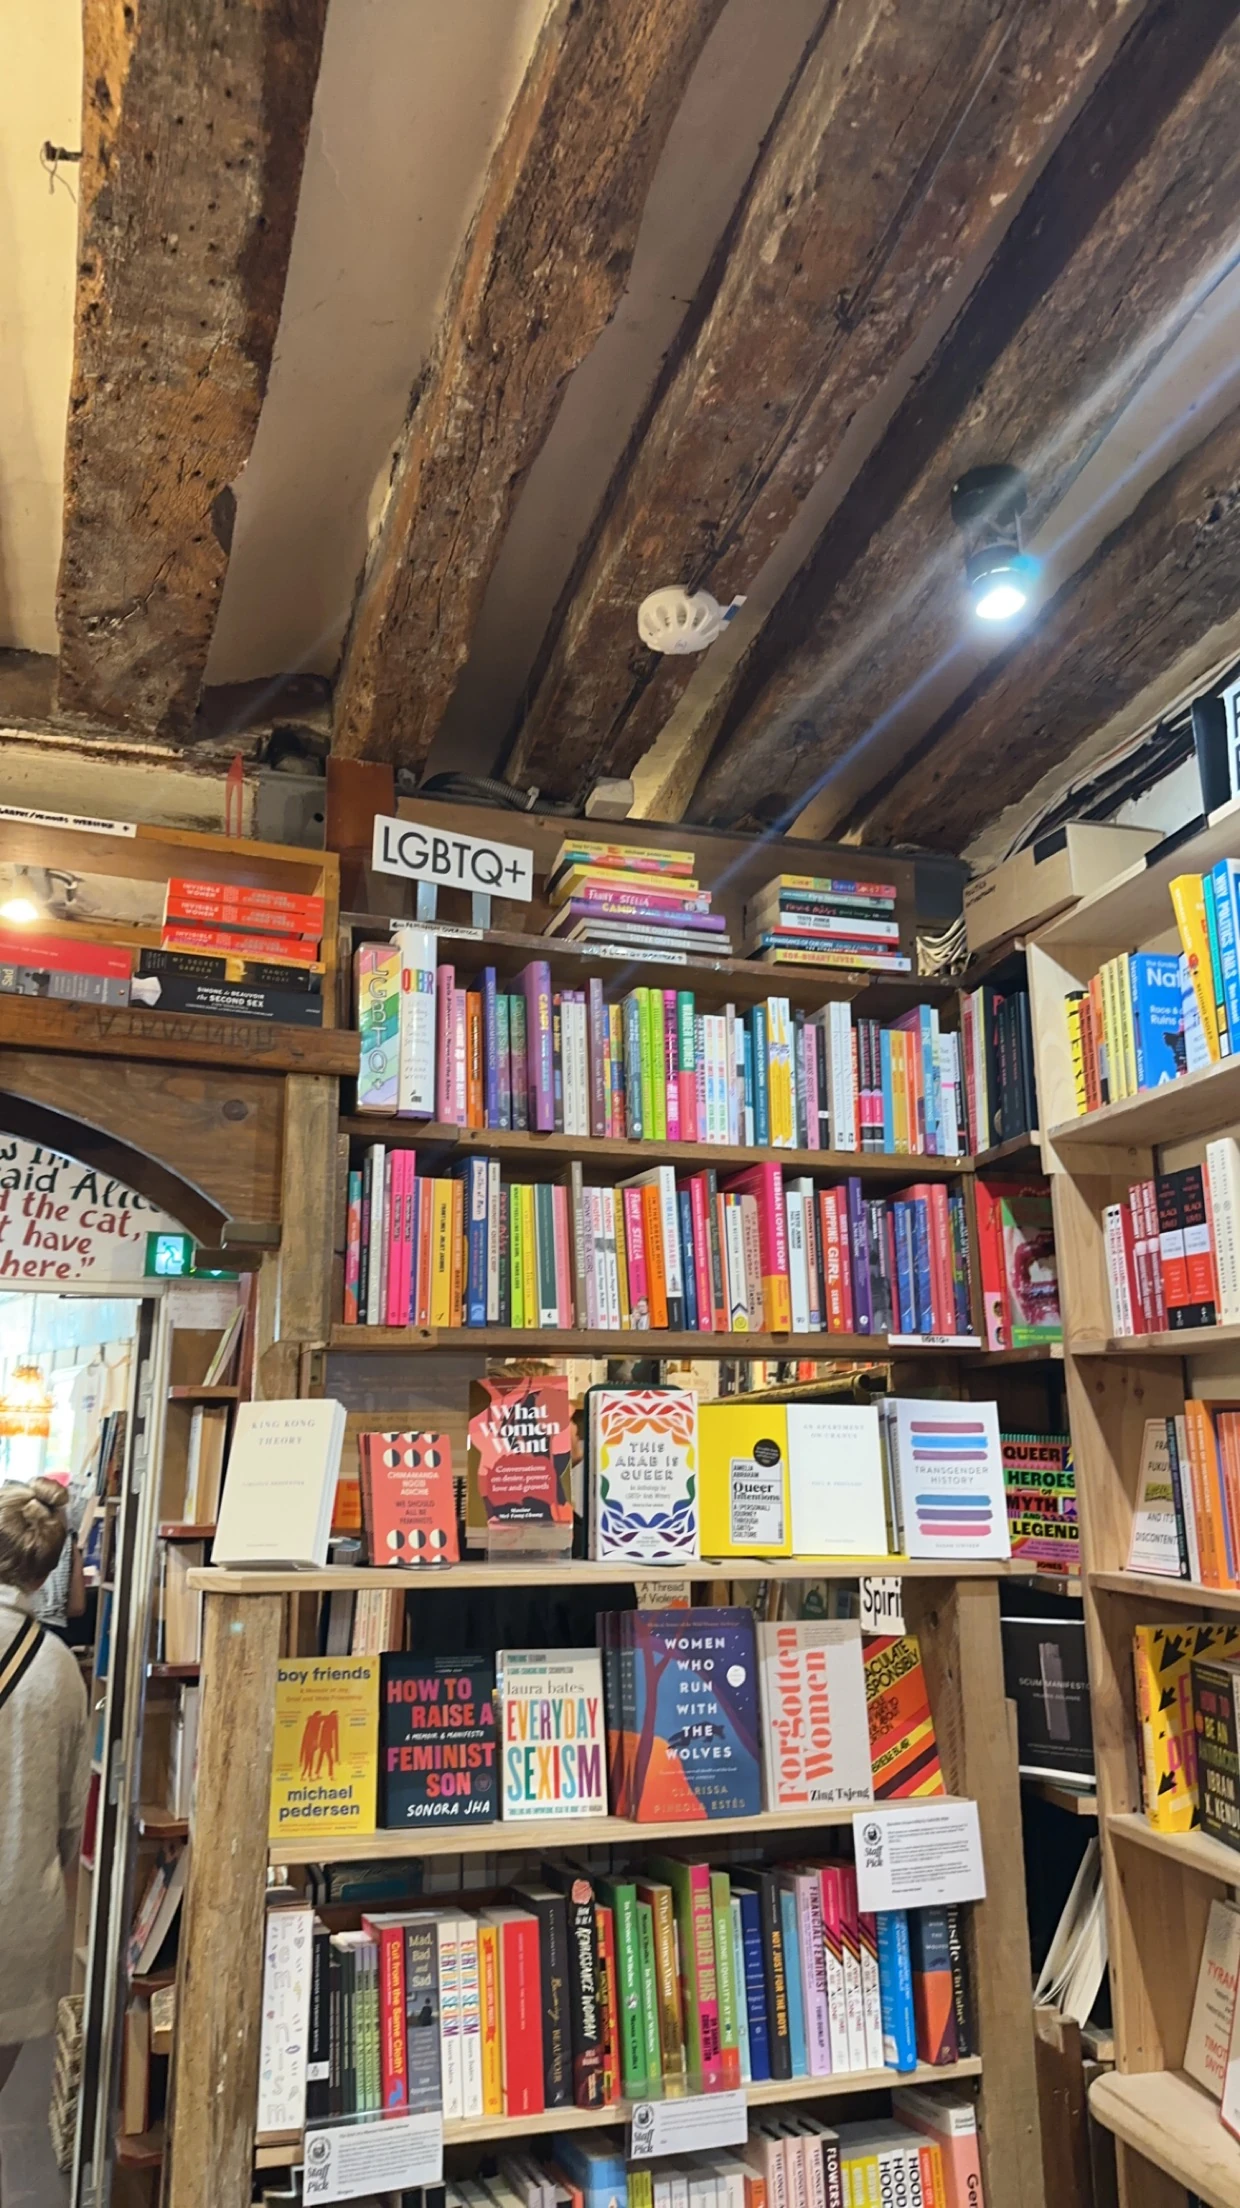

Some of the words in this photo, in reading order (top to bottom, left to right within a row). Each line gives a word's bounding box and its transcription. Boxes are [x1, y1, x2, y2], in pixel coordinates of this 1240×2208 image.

[383, 826, 525, 887] LGBTQ+
[1215, 871, 1228, 897] WHY
[1218, 901, 1234, 948] POLITICS
[1223, 950, 1237, 980] FAILS
[209, 995, 245, 1005] SECOND
[247, 1000, 264, 1008] SEX
[1150, 1014, 1175, 1025] Ruins
[683, 1038, 694, 1068] WOMEN
[0, 1167, 59, 1193] aid
[69, 1169, 162, 1213] Alic
[773, 1171, 783, 1210] LESBIAN
[23, 1191, 70, 1221] the
[80, 1210, 141, 1242] cat,
[576, 1209, 584, 1235] SISTER
[605, 1196, 613, 1232] Amateur
[824, 1196, 839, 1243] WHIPPING
[774, 1213, 784, 1237] LOVE
[23, 1219, 92, 1254] have
[632, 1227, 644, 1260] STELLA
[577, 1237, 585, 1278] OUTSIDER
[667, 1229, 676, 1269] HUSBANDS
[776, 1240, 785, 1271] STORY
[827, 1247, 839, 1285] GIRL
[831, 1289, 840, 1315] SERANO
[491, 1404, 548, 1421] What
[251, 1419, 279, 1429] KING
[284, 1419, 316, 1428] KONG
[479, 1421, 560, 1438] Women
[258, 1436, 303, 1446] THEORY
[492, 1438, 549, 1454] Want
[629, 1442, 665, 1453] THIS
[615, 1456, 661, 1467] ARAB
[665, 1456, 679, 1467] IS
[1003, 1446, 1061, 1462] QUEER
[495, 1464, 546, 1474] Conversations
[620, 1470, 674, 1481] QUEER
[915, 1466, 989, 1474] TRANSGENDER
[1008, 1471, 1075, 1487] HEROES
[492, 1484, 508, 1492] love
[523, 1483, 550, 1493] growth
[733, 1482, 774, 1493] Queer
[930, 1477, 973, 1485] HISTORY
[1007, 1495, 1058, 1512] MYTH
[1023, 1512, 1041, 1520] AND
[1013, 1521, 1079, 1539] LEGEND
[652, 1582, 685, 1592] Thread
[664, 1637, 726, 1650] WOMEN
[278, 1668, 308, 1685] boy
[313, 1666, 371, 1681] friends
[676, 1659, 715, 1671] WHO
[387, 1679, 440, 1703] HOW
[444, 1677, 472, 1700] TO
[507, 1680, 543, 1695] laura
[548, 1680, 585, 1694] bates
[679, 1681, 713, 1693] RUN
[411, 1703, 475, 1729] RAISE
[479, 1704, 494, 1725] A
[507, 1697, 598, 1741] EVERYDAY
[675, 1703, 718, 1716] WITH
[772, 1627, 809, 1804] Forgotten
[803, 1651, 835, 1782] Women
[411, 1732, 438, 1741] MEMOIR
[446, 1730, 484, 1739] MANIFESTO
[682, 1725, 714, 1737] THE
[387, 1742, 496, 1773] FEMINIST
[665, 1746, 732, 1760] WOLVES
[507, 1744, 602, 1801] SEXISM
[287, 1785, 353, 1801] michael
[426, 1772, 471, 1798] SON
[671, 1785, 729, 1797] CLARISSA
[810, 1789, 835, 1802] Zing
[835, 1787, 871, 1802] Tsjeng
[279, 1803, 360, 1821] pedersen
[406, 1802, 459, 1818] SONORA
[464, 1800, 490, 1814] JHA
[864, 1845, 883, 1858] Staff
[866, 1858, 883, 1868] Pick
[660, 1895, 668, 1924] What
[694, 1888, 710, 1911] THE
[809, 1886, 823, 1940] FINANCIAL
[392, 1941, 401, 1959] Cut
[408, 1933, 433, 1947] Mad,
[662, 1925, 671, 1970] Women
[694, 1914, 714, 1966] GENDER
[719, 1919, 728, 1962] CREATING
[771, 1931, 781, 1948] NOT
[412, 1950, 430, 1961] Bad
[460, 1940, 478, 1989] EVERYDAY
[575, 1927, 595, 1992] RENAISSANCE
[772, 1950, 783, 1973] JUST
[392, 1962, 402, 1982] from
[441, 1942, 458, 1991] EVERYDAY
[813, 1943, 826, 1993] FEMINIST
[1208, 1960, 1237, 1992] TYRAN
[412, 1974, 432, 1987] Sad
[664, 1971, 672, 1997] Want
[698, 1968, 716, 2002] BIAS
[721, 1963, 731, 2003] EQUALITY
[774, 1975, 784, 1992] FOR
[393, 1984, 402, 2002] the
[775, 1994, 785, 2011] THE
[442, 1994, 459, 2037] SEXISM
[462, 1993, 479, 2035] SEXISM
[580, 1996, 596, 2040] WOMAN
[777, 2013, 788, 2037] BOYS
[552, 2029, 562, 2084] BEAUVOIR
[307, 2163, 332, 2181] Staff
[827, 2147, 840, 2208] FLOWERS
[307, 2180, 329, 2194] Pick
